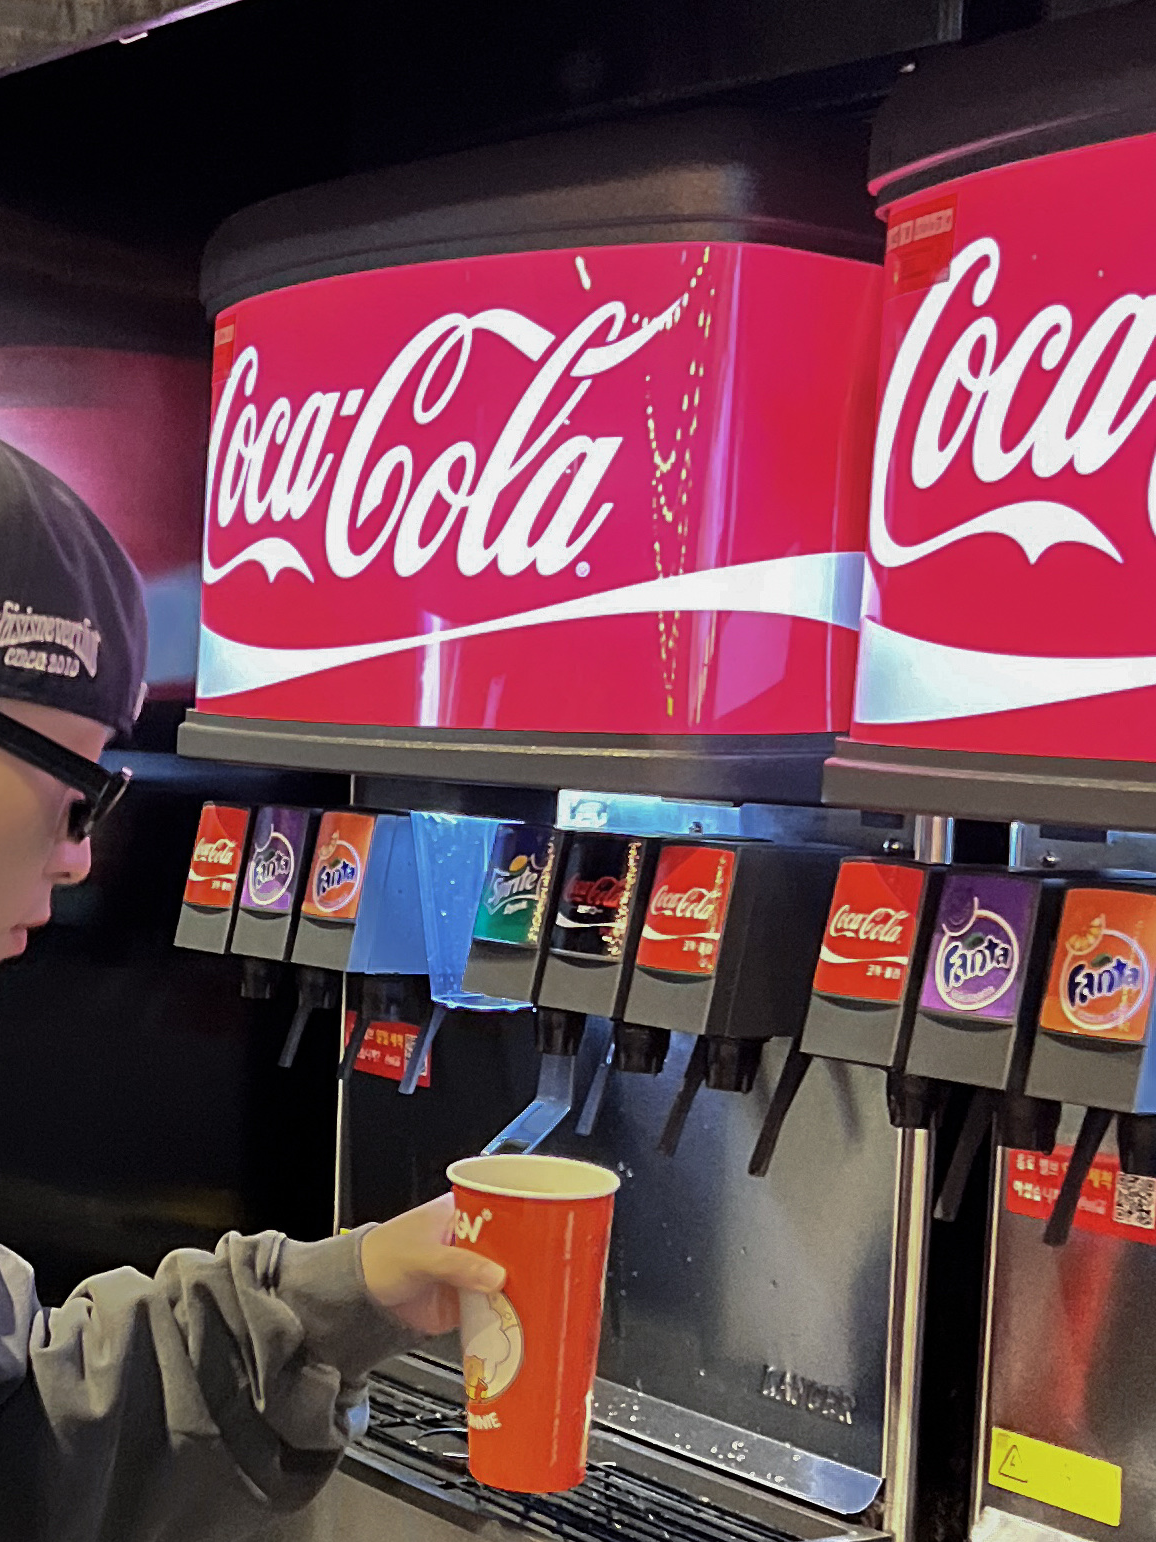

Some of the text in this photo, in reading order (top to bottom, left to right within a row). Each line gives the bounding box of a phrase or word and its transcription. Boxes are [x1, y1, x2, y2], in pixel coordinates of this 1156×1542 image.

[202, 299, 682, 583] Coca-Cola
[317, 858, 358, 897] Fanta
[651, 885, 721, 920] Coca-Cola
[829, 904, 909, 943] Coca-Cola
[943, 935, 1011, 991] Fanta
[1066, 956, 1142, 1007] Fanta
